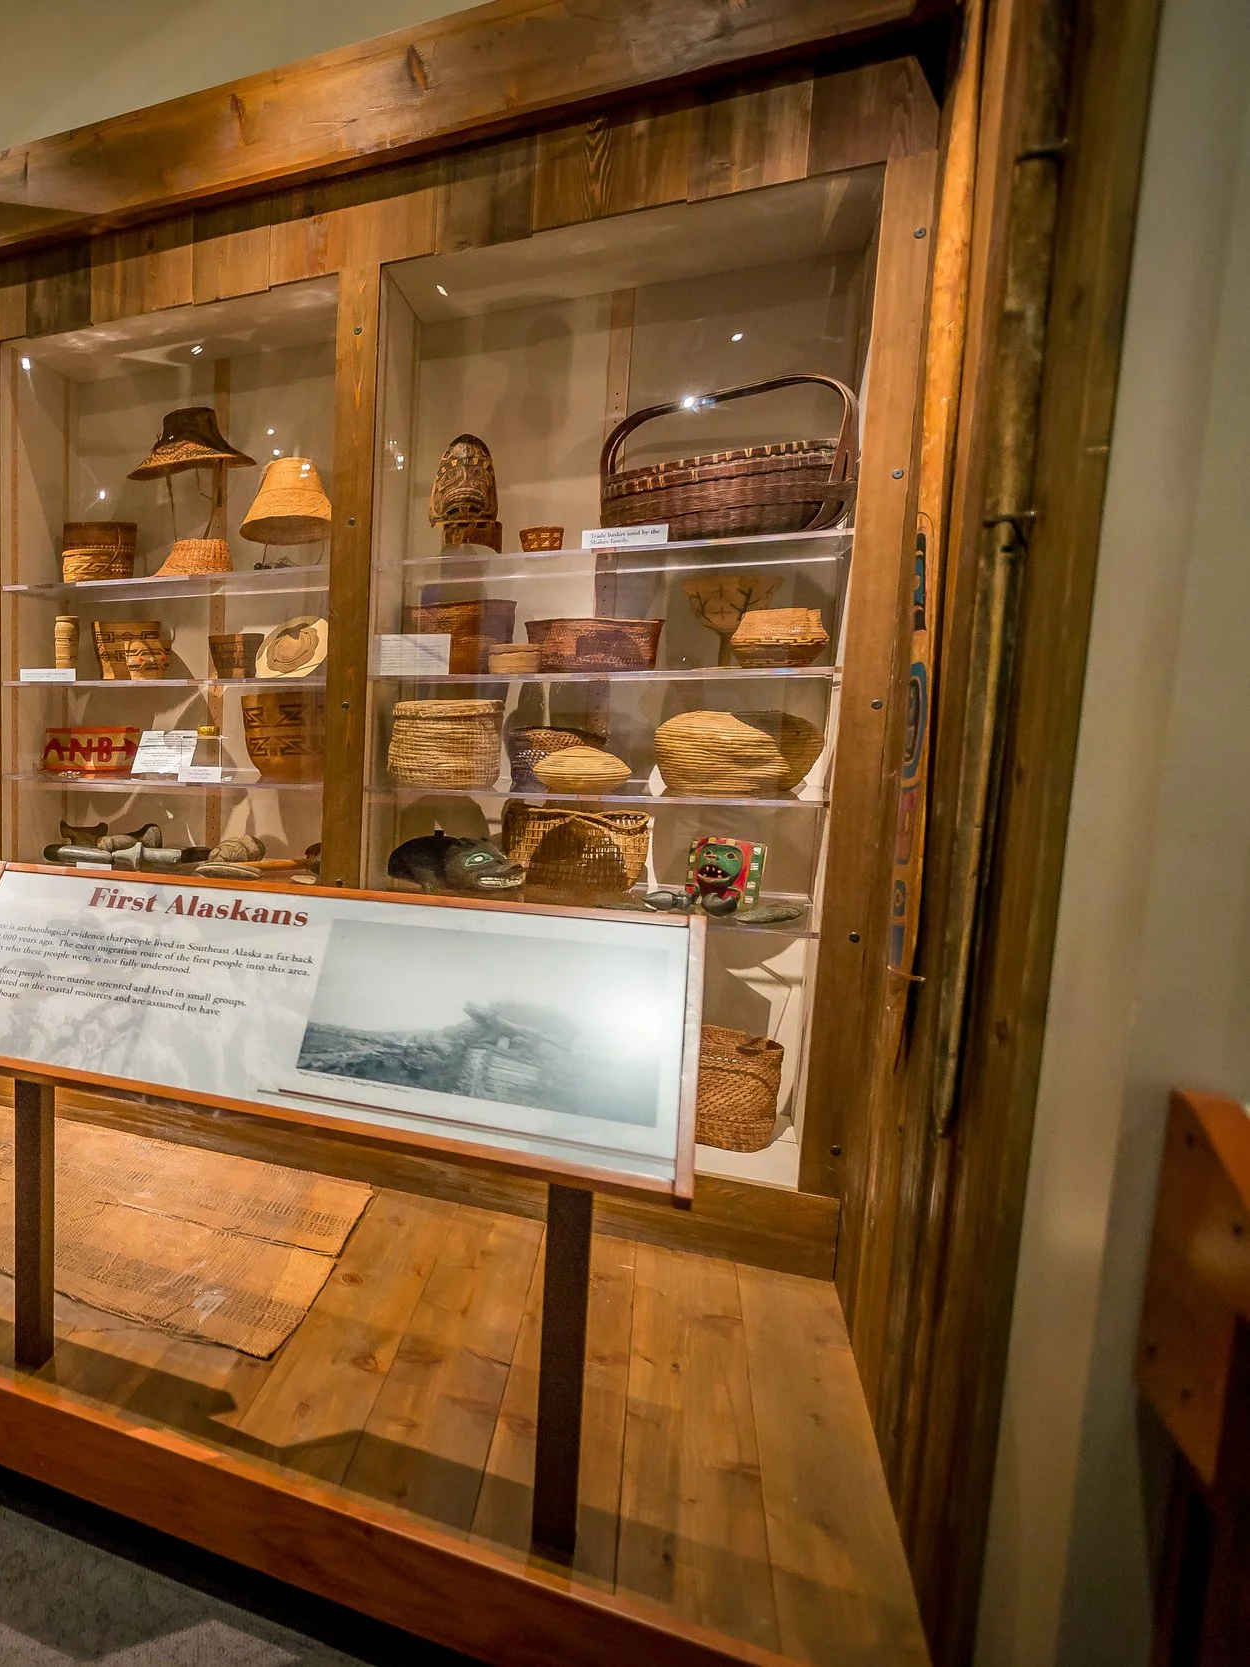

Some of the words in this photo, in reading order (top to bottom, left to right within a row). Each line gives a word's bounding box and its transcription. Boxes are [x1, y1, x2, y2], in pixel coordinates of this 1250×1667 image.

[88, 887, 157, 912] First
[165, 895, 308, 927] Alaskans
[5, 943, 21, 953] who
[23, 946, 41, 955] these
[43, 949, 70, 961] people
[103, 957, 117, 965] not
[120, 956, 139, 968] fully
[141, 961, 191, 975] understood.
[17, 925, 70, 938] archaeological
[71, 930, 104, 940] evidence
[107, 933, 123, 942] that
[124, 937, 152, 947] people
[154, 939, 174, 948] lived
[187, 943, 230, 955] Southeast
[233, 948, 261, 958] Alaska
[276, 952, 290, 961] far
[291, 955, 314, 964] back
[18, 936, 36, 945] years
[39, 939, 54, 947] ago.
[58, 940, 73, 948] The
[75, 943, 95, 951] exact
[97, 945, 137, 956] migration
[165, 952, 176, 960] of
[177, 954, 191, 962] the
[192, 955, 211, 965] first
[212, 959, 243, 969] people
[246, 961, 265, 971] into
[268, 963, 285, 973] this
[19, 969, 45, 980] people
[47, 974, 66, 982] were
[67, 975, 96, 986] marine
[97, 980, 132, 991] oriented
[133, 984, 150, 993] and
[152, 985, 173, 996] lived
[175, 989, 184, 998] in
[187, 992, 211, 1001] small
[213, 996, 247, 1007] groups.
[32, 981, 45, 990] the
[46, 985, 73, 995] coastal
[75, 989, 112, 1001] resources
[114, 993, 131, 1003] and
[132, 997, 145, 1005] are
[147, 999, 185, 1012] assumed
[200, 1005, 220, 1015] have
